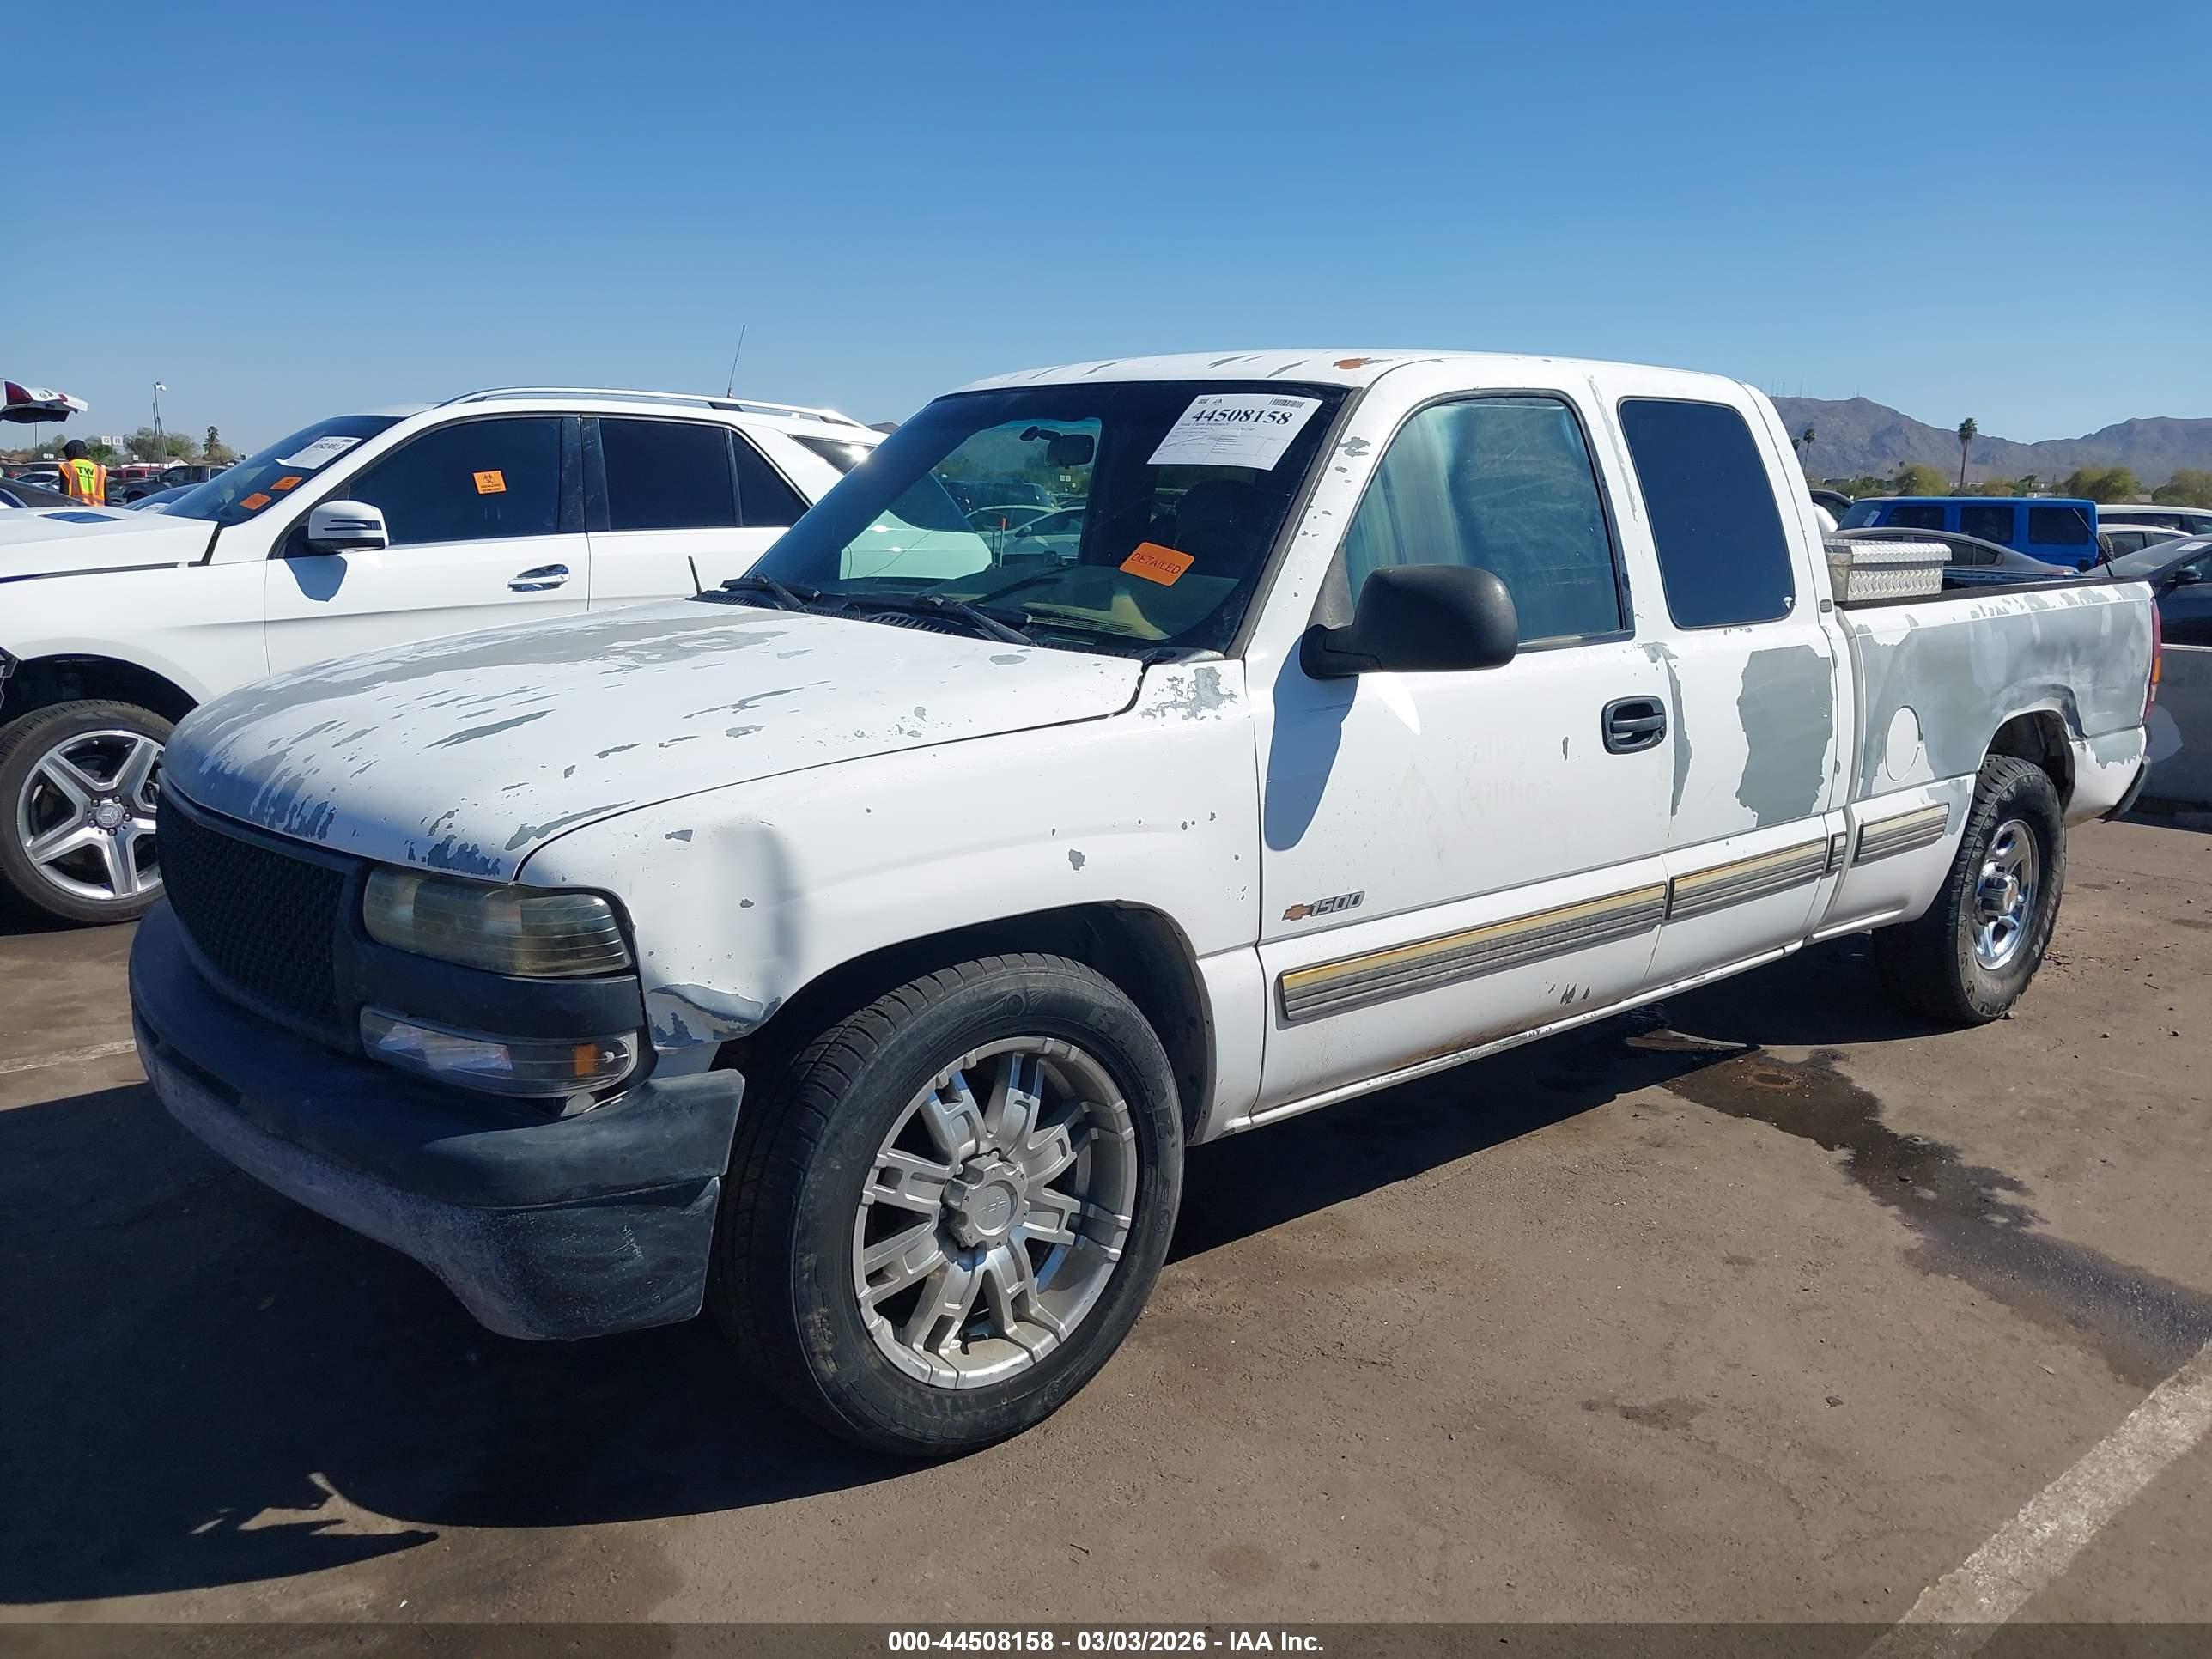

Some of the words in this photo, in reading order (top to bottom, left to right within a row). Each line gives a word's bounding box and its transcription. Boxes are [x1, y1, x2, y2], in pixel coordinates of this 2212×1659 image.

[1192, 409, 1293, 425] 44508158
[76, 466, 94, 476] TW
[1131, 552, 1182, 574] DETAILED
[1311, 891, 1365, 916] 1500
